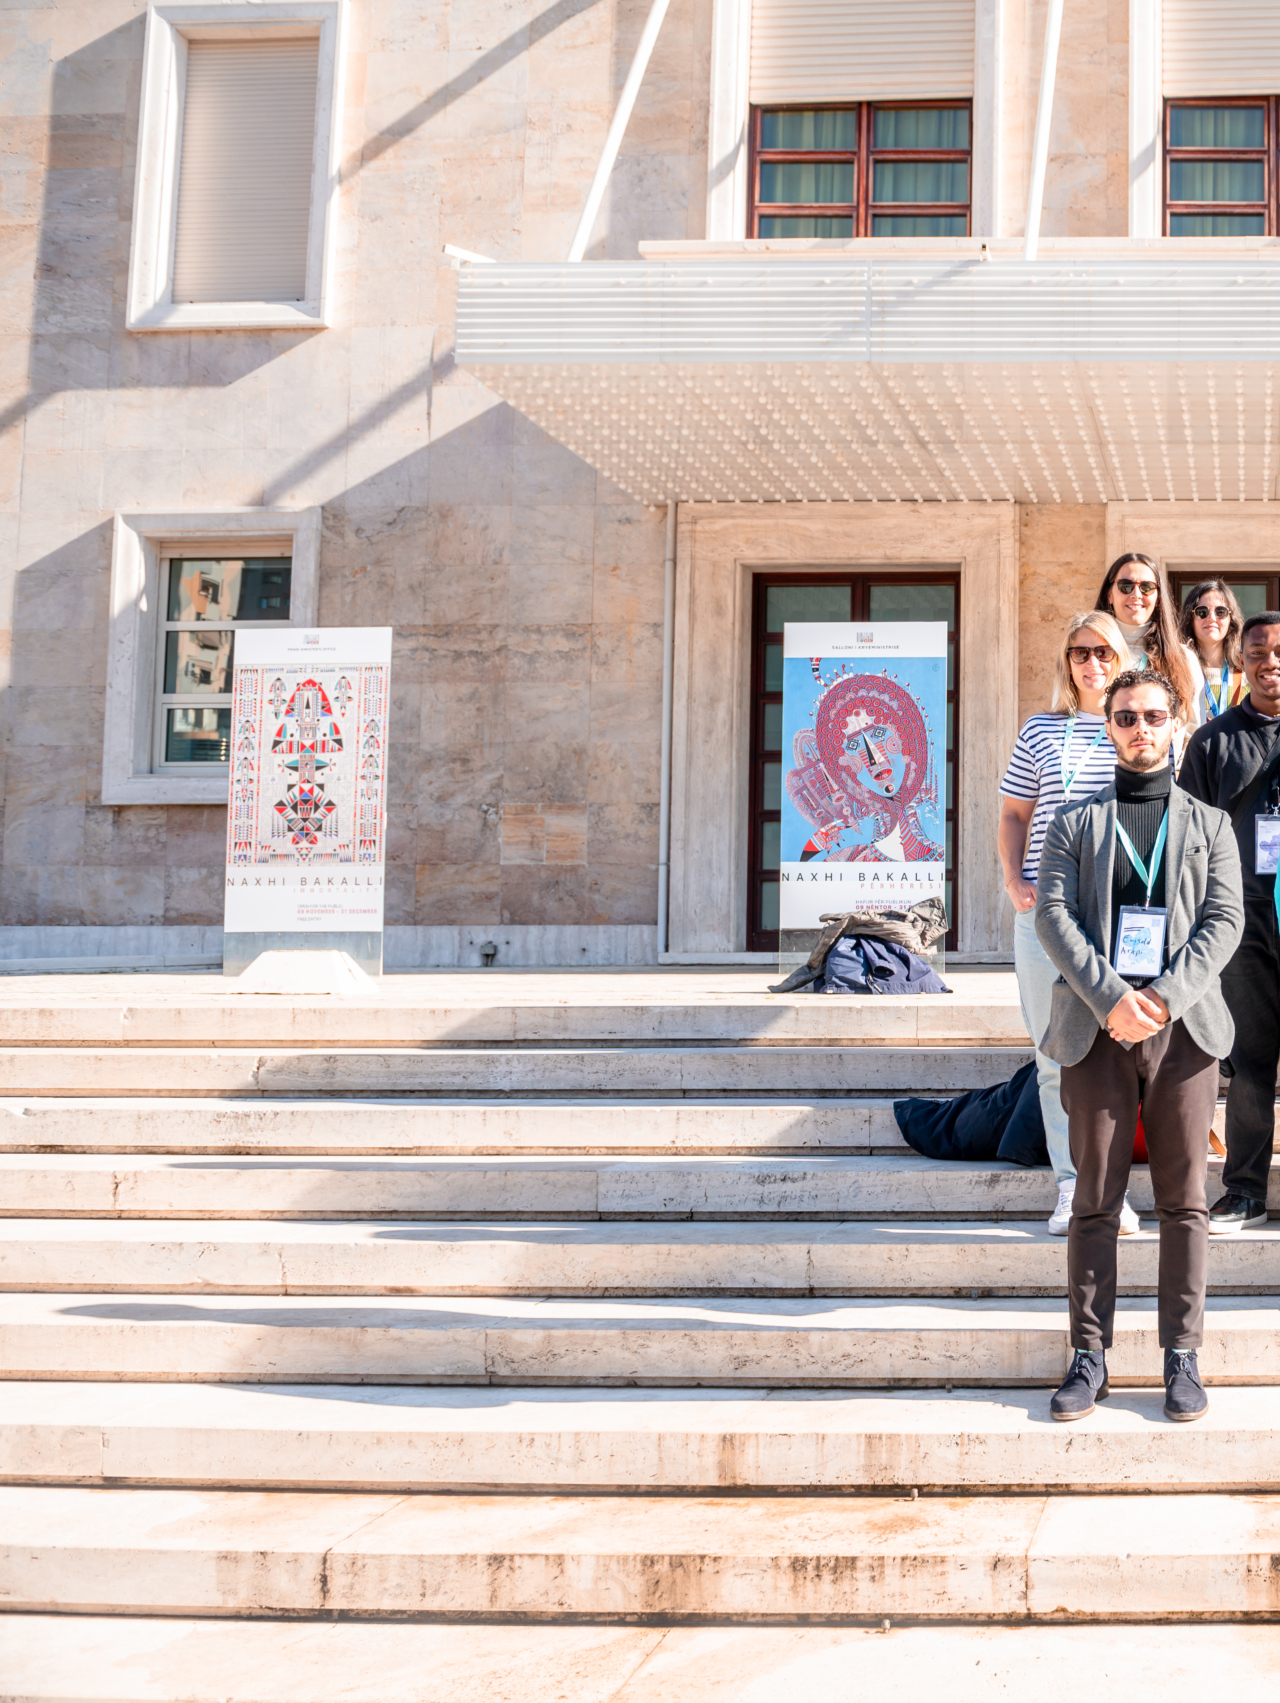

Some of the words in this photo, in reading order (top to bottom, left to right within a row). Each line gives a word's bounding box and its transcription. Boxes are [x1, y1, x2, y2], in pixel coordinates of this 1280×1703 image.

[227, 877, 285, 886] NAXHI
[300, 877, 382, 886] BAKALLI
[782, 873, 843, 881] NAXHI
[858, 873, 943, 881] BAKALLI
[1121, 947, 1143, 956] Arapi
